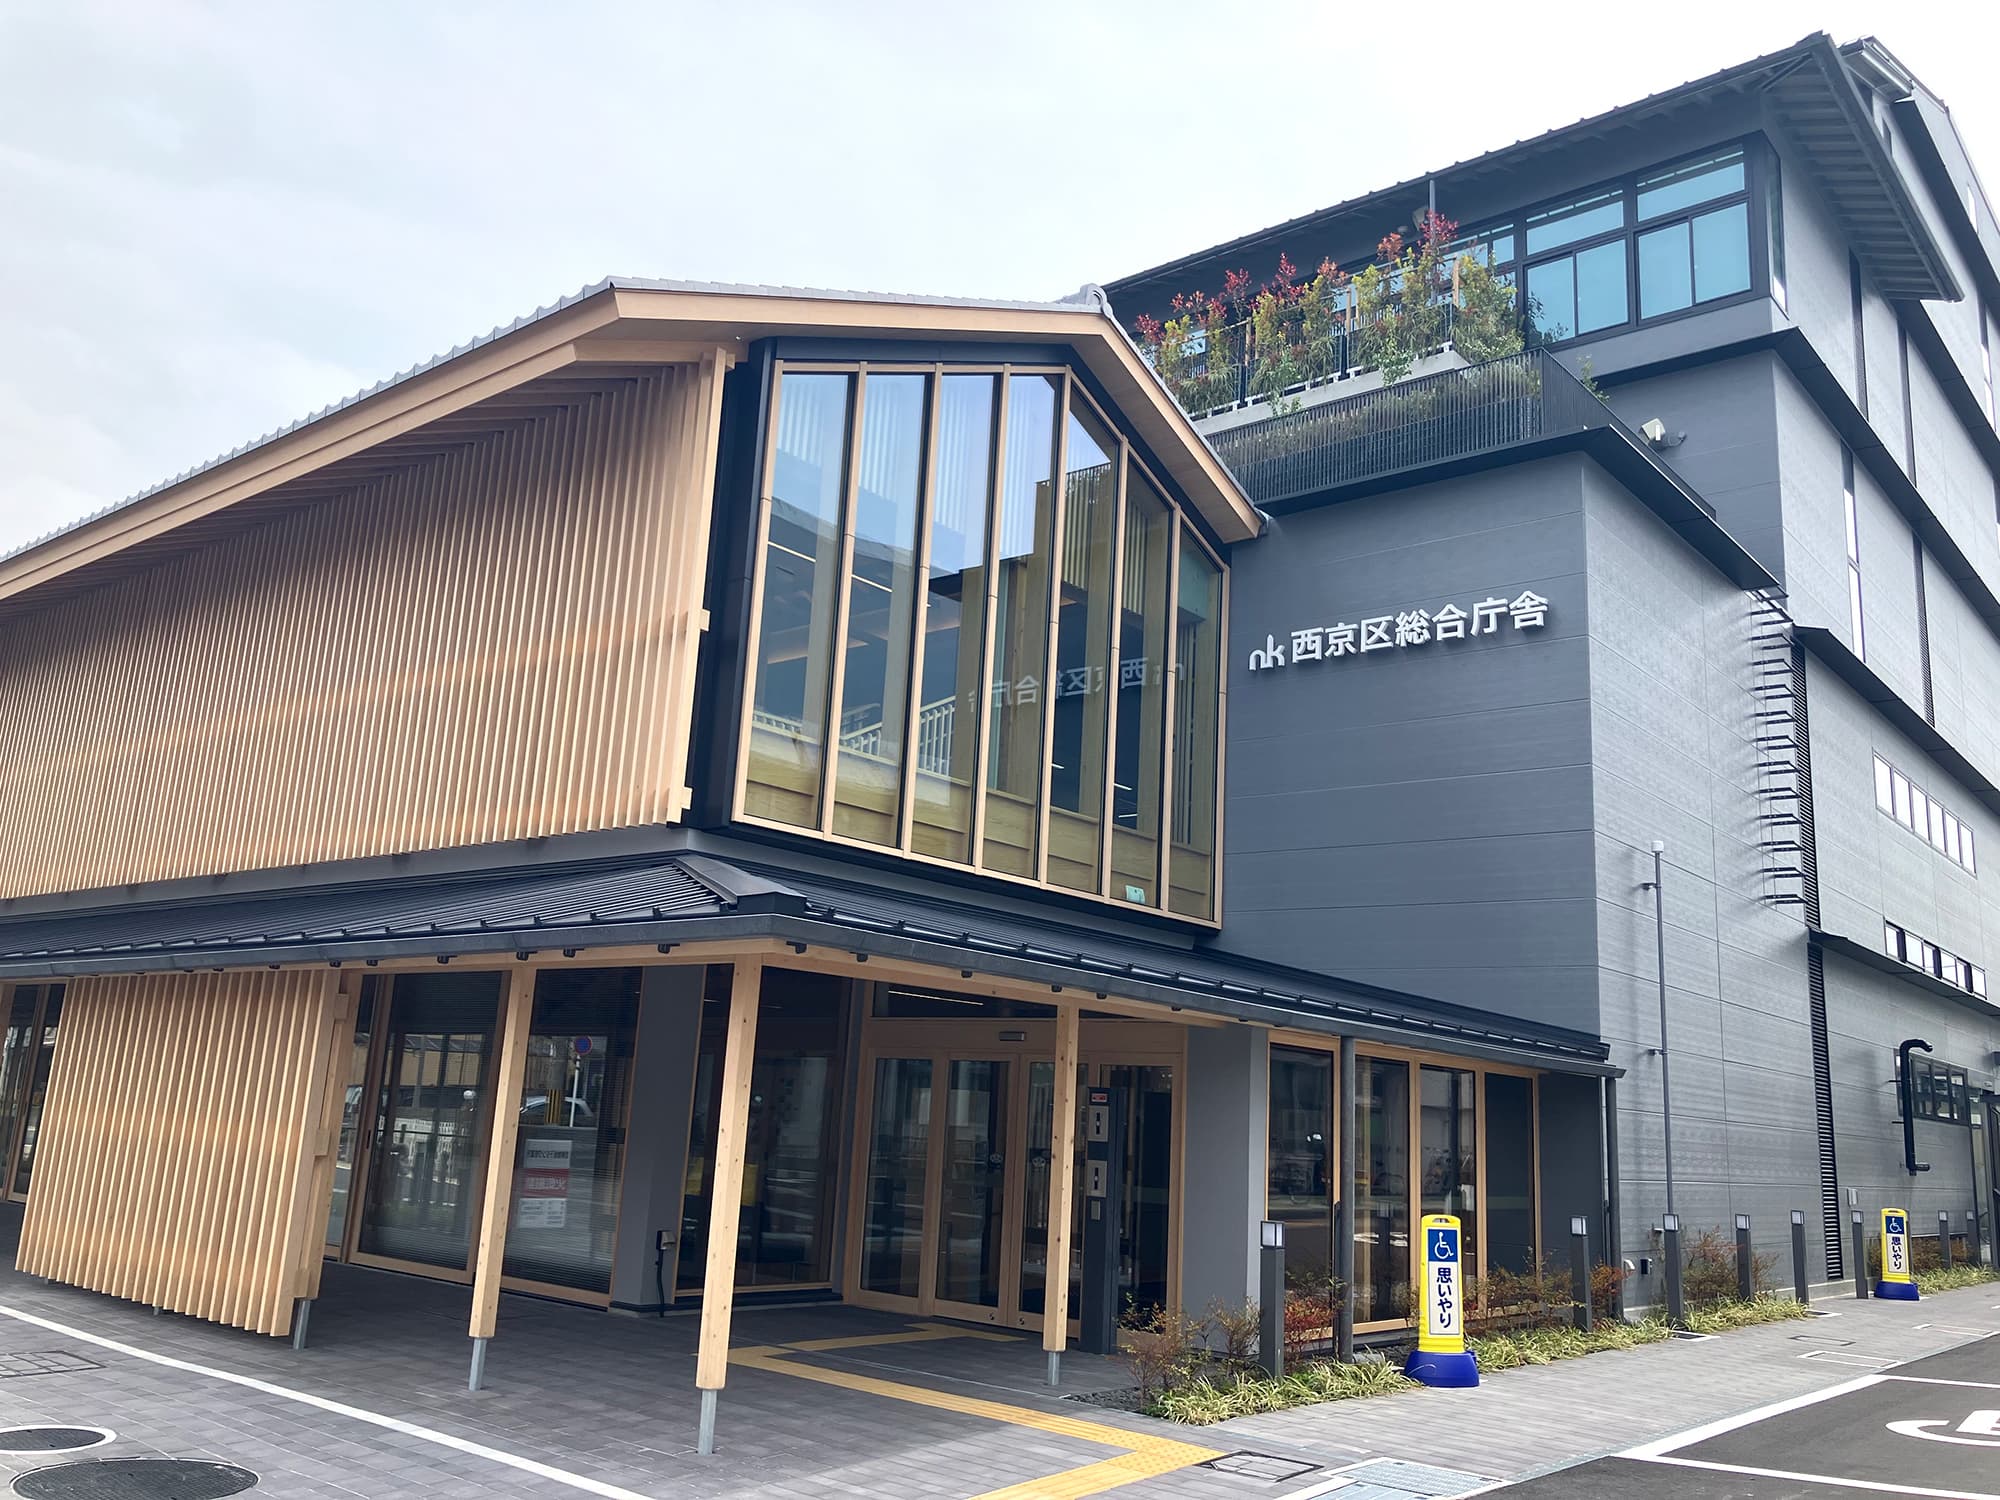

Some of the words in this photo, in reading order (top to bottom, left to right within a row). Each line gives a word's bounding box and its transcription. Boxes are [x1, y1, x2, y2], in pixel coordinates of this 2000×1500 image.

[1290, 590, 1549, 664] 西京区総合庁舎
[1891, 1237, 1902, 1270] 思いやり
[1436, 1267, 1453, 1329] 思いやり
